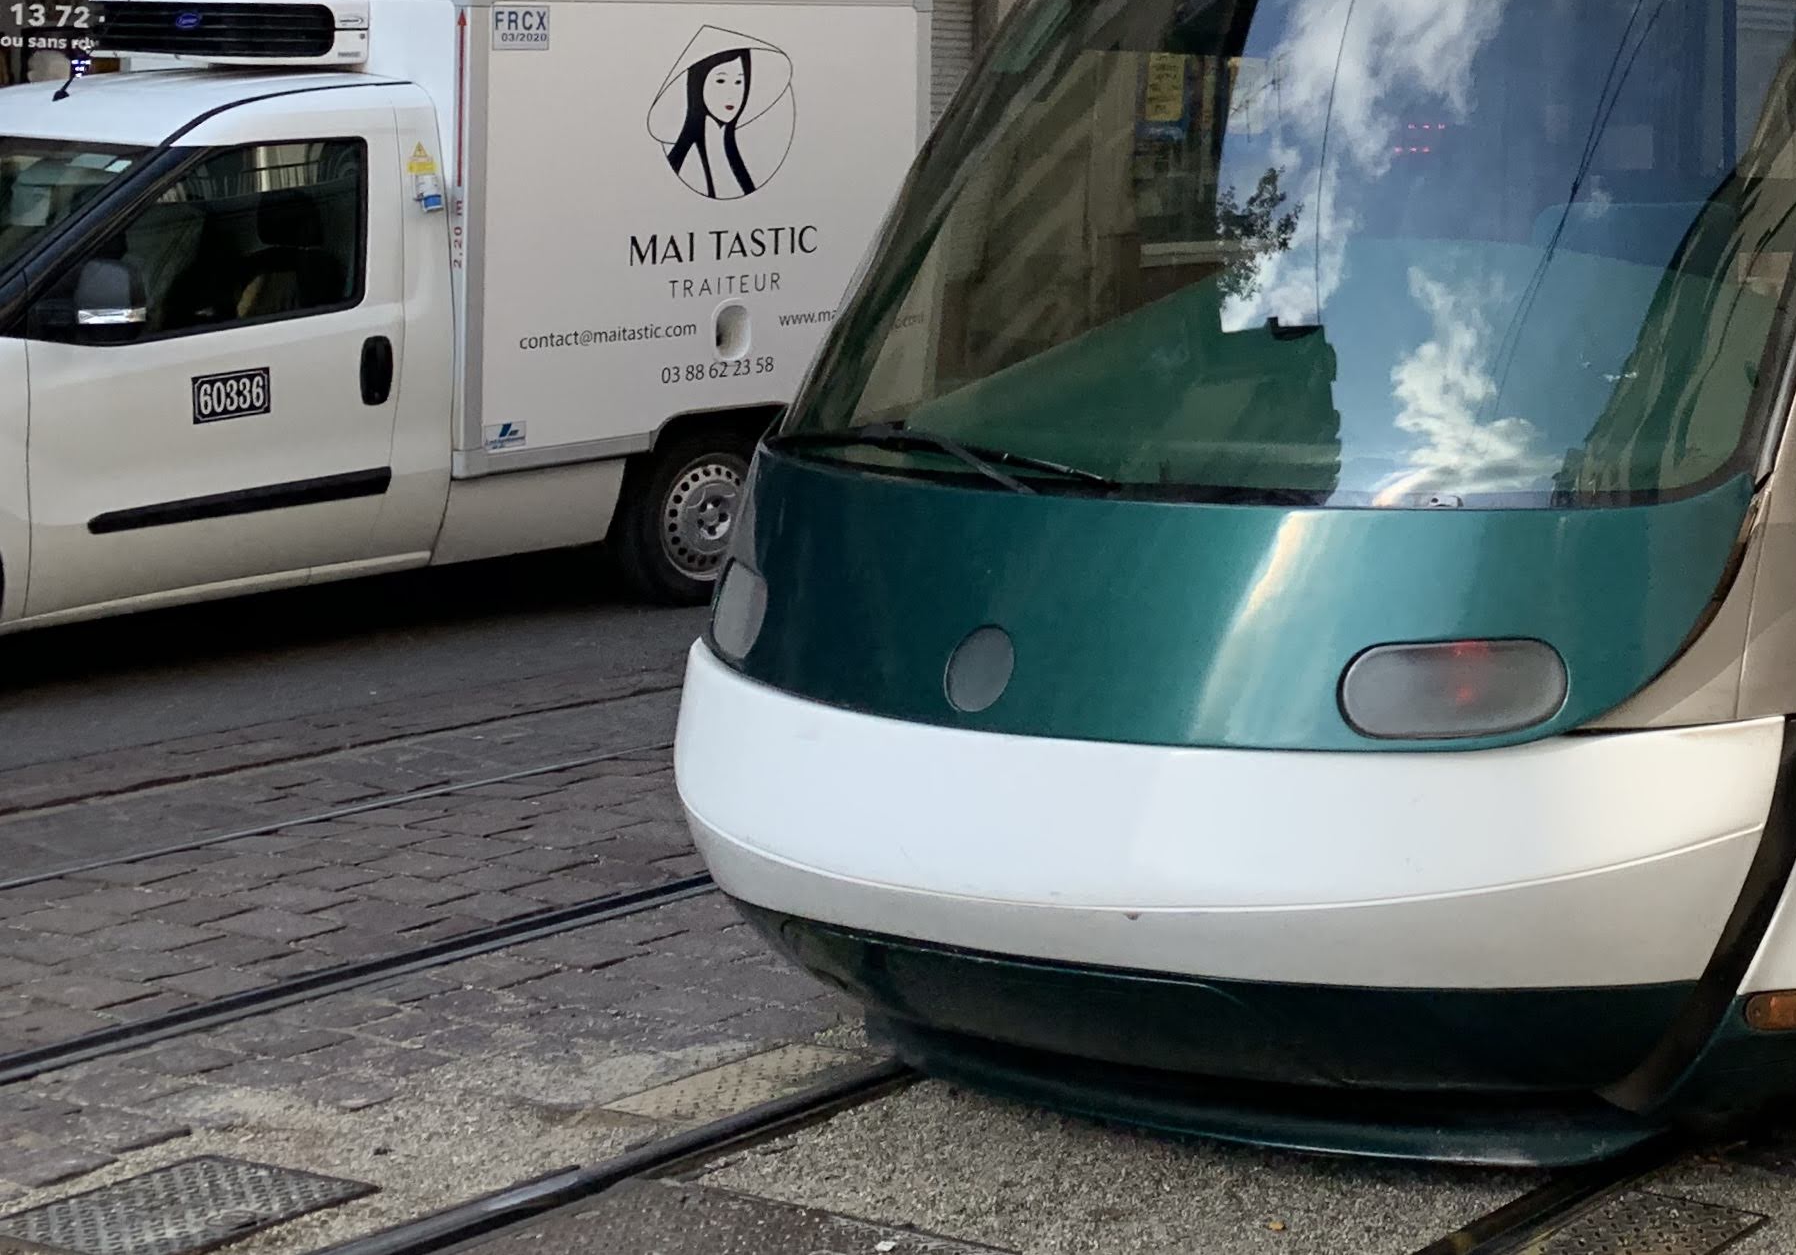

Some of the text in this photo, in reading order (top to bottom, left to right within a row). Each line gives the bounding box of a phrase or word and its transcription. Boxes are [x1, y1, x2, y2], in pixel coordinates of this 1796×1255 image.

[10, 2, 91, 29] 13 72
[495, 10, 547, 31] FRCX
[0, 35, 23, 47] ou
[28, 35, 67, 49] sans
[501, 32, 548, 43] 03/2020
[629, 225, 818, 267] MAI TASTIC
[668, 272, 781, 299] TRAITEUR
[519, 323, 697, 350] contact@maitastic.com
[661, 356, 775, 384] 03 88 62 23 58
[200, 375, 264, 415] 60336
